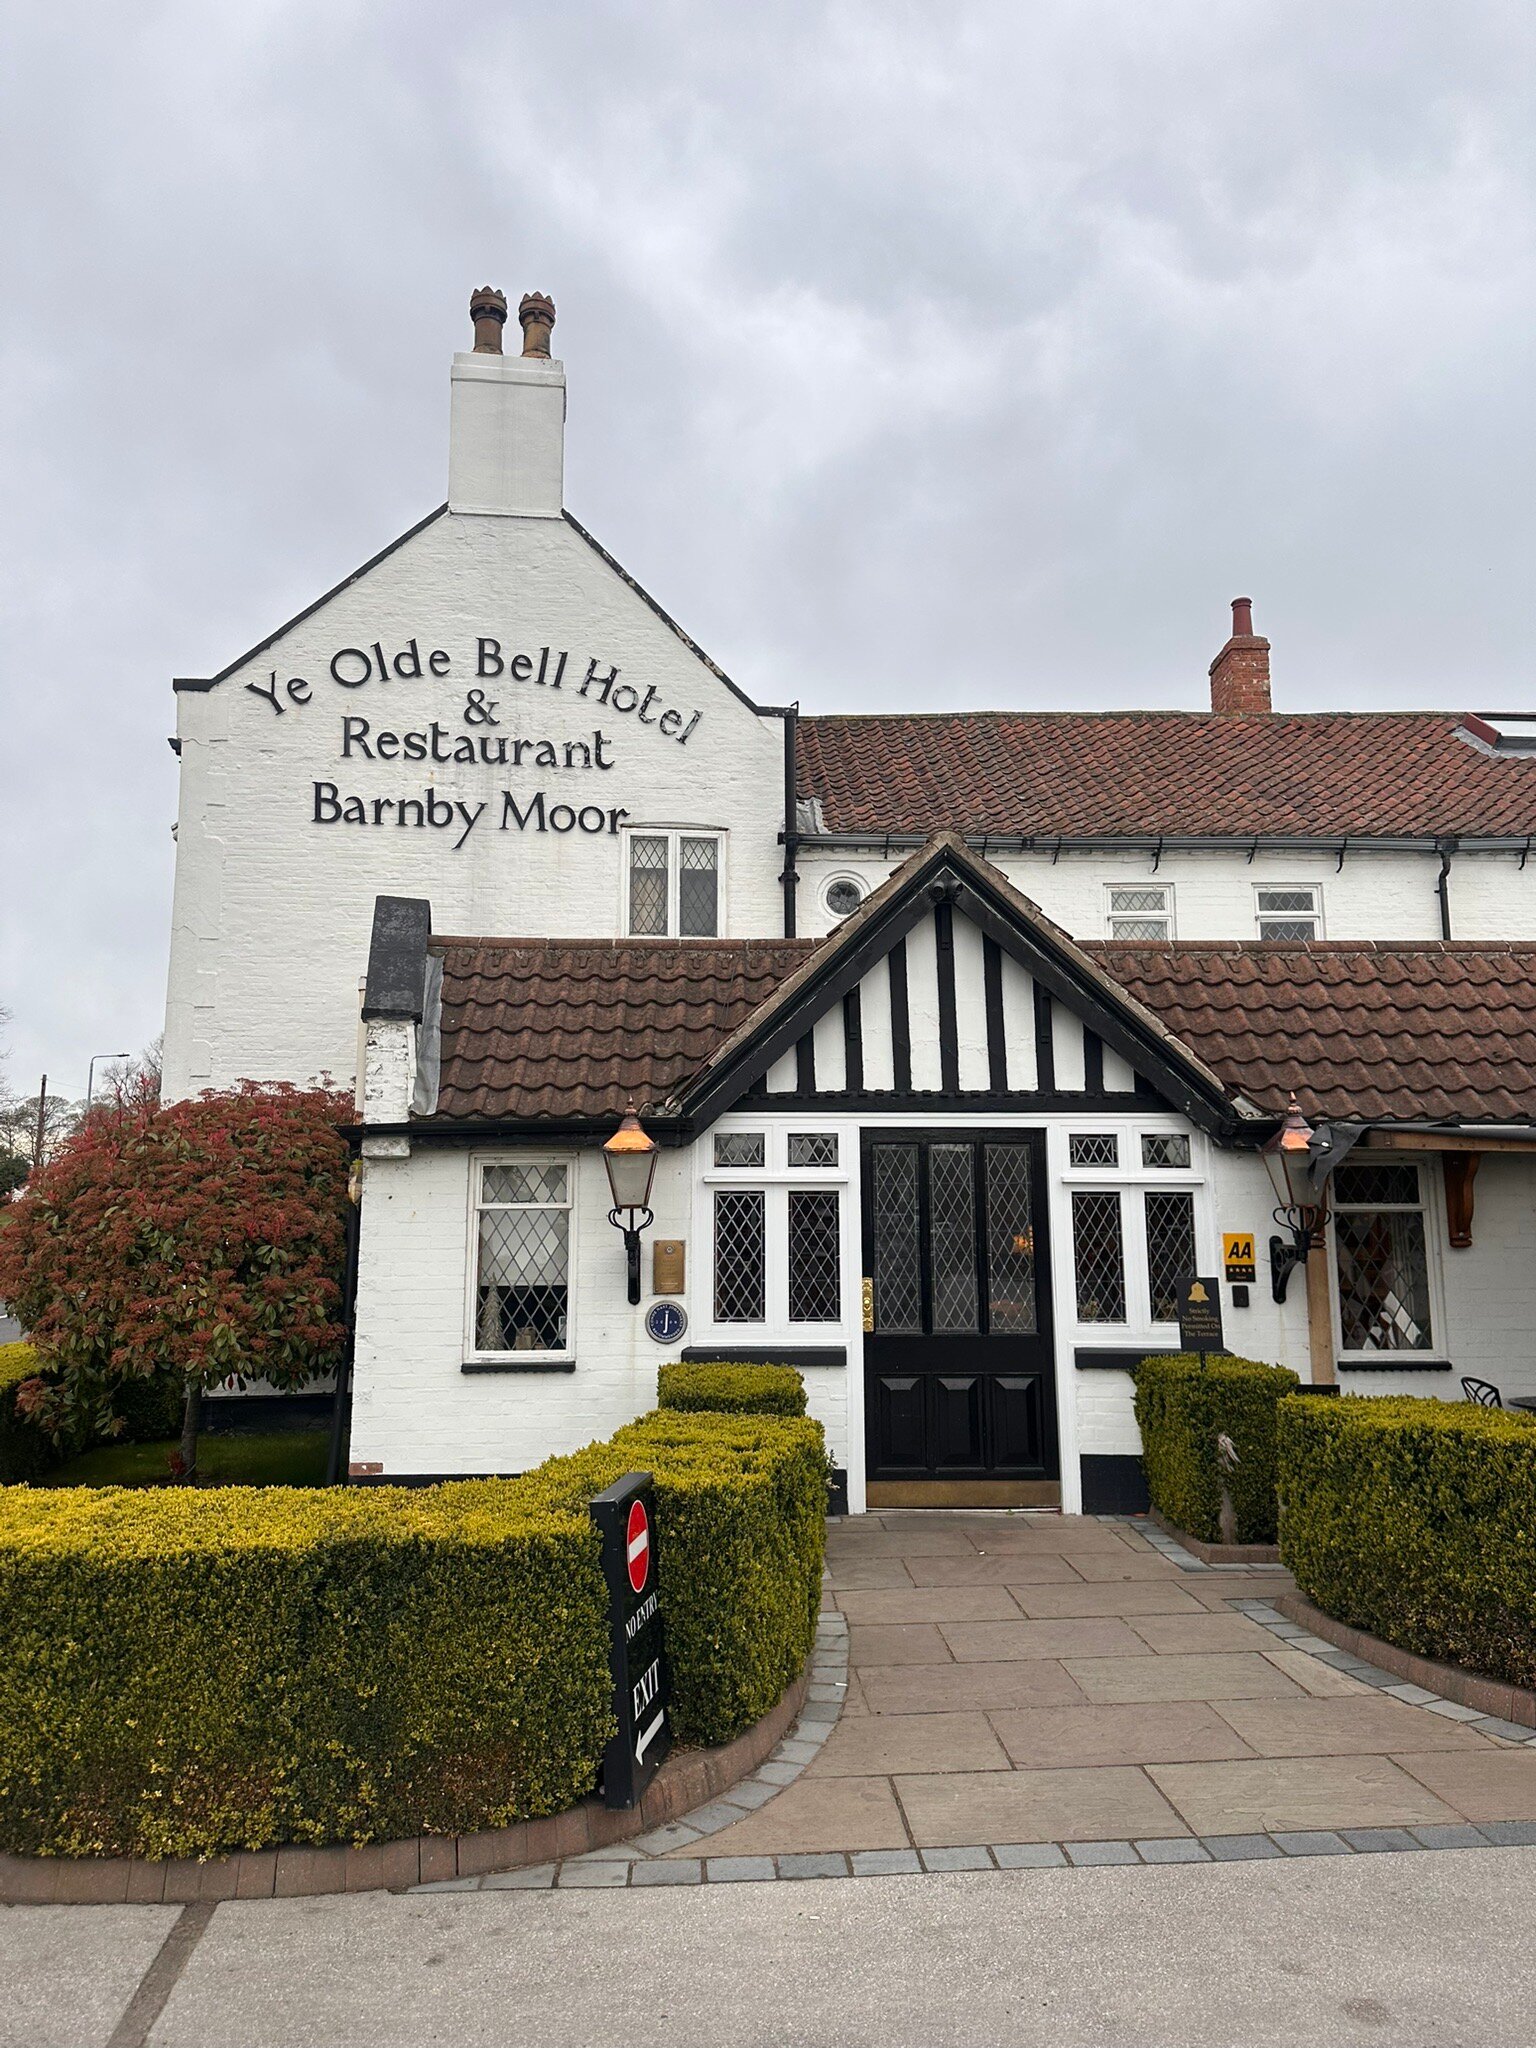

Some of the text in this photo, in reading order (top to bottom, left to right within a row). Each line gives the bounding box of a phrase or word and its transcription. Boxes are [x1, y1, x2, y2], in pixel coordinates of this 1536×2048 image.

[244, 637, 703, 745] Ye Olde Bell Hotel
[463, 688, 501, 727] &
[340, 715, 616, 771] Restaurant
[311, 781, 631, 851] Barnby Moor
[1228, 1242, 1252, 1259] AA
[625, 1592, 658, 1644] NO ENTRY
[632, 1657, 660, 1722] EXIT
